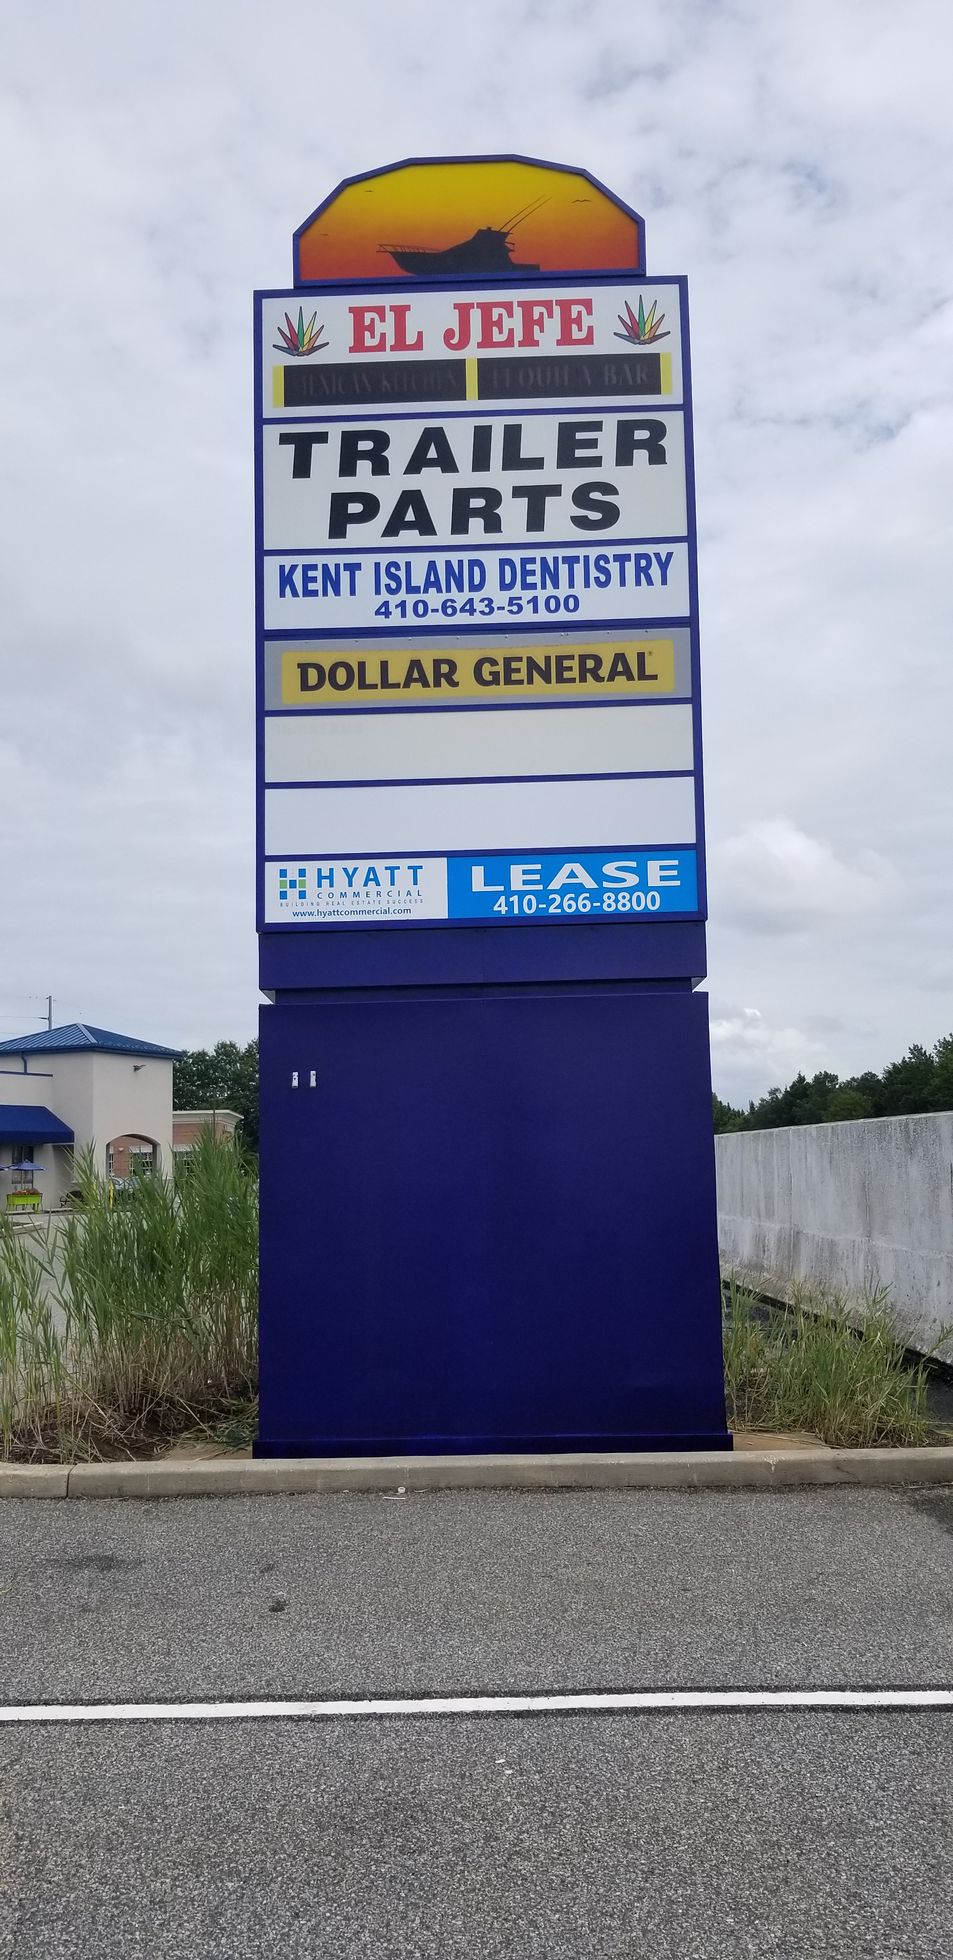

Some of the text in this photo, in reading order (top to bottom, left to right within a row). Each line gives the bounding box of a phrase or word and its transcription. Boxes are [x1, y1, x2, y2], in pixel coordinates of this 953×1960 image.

[348, 298, 594, 354] EL JEFE
[603, 363, 649, 386] BAR
[278, 418, 668, 479] TRAILER
[328, 481, 621, 540] PARTS
[278, 551, 675, 599] KENT ISLAND DENTISTRY
[374, 593, 581, 619] 410-643-5100
[296, 651, 659, 692] DOLLAR GENERAL
[316, 865, 424, 889] HYATT
[471, 860, 682, 893] LEASE
[316, 889, 423, 900] COMMERCIAL
[325, 899, 346, 907] REAL
[492, 891, 662, 916] 410-266-8800
[292, 906, 412, 919] www.hyattcommercial.com
